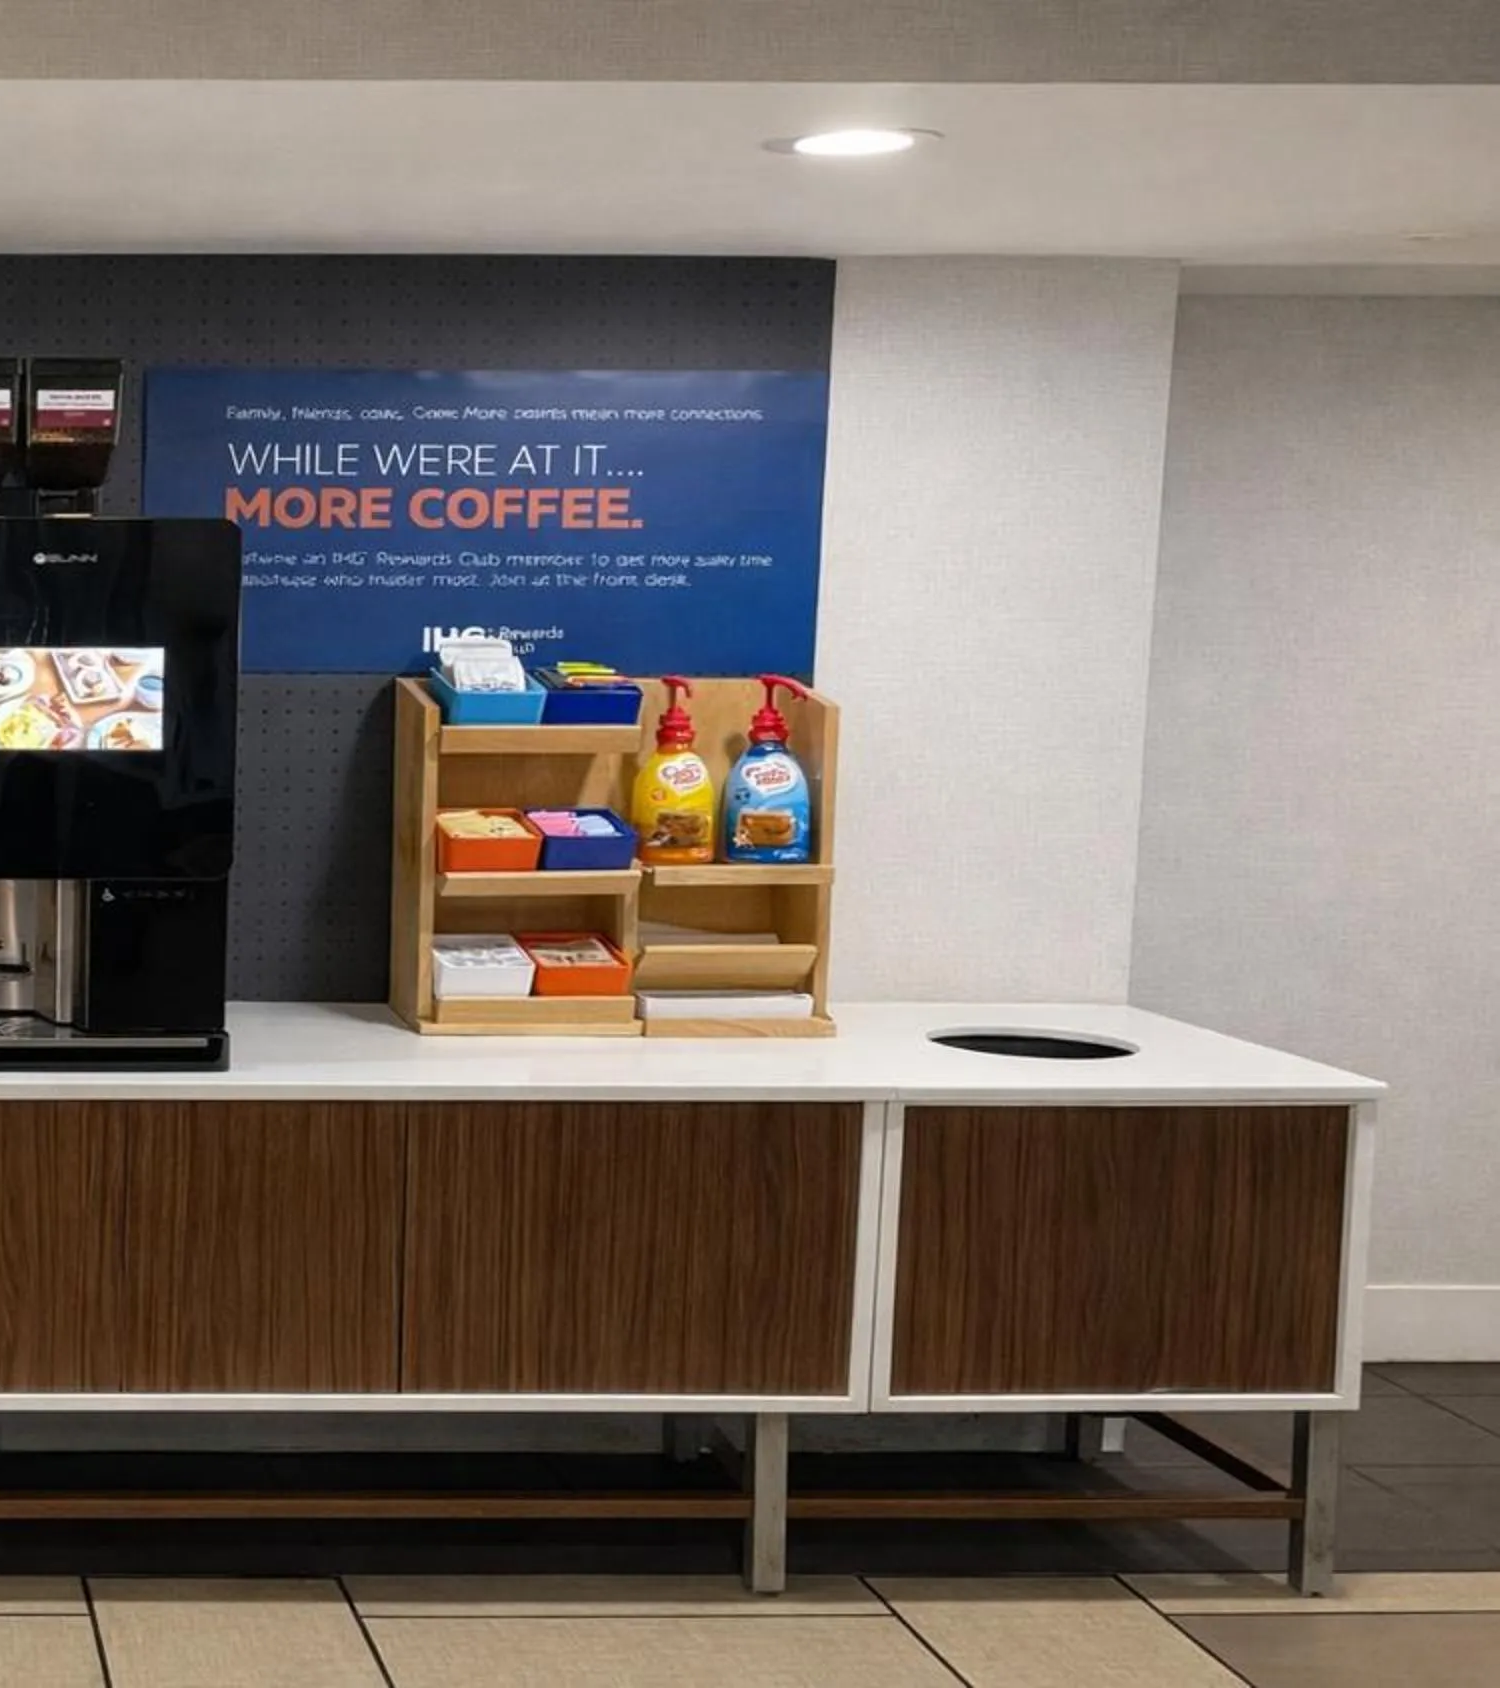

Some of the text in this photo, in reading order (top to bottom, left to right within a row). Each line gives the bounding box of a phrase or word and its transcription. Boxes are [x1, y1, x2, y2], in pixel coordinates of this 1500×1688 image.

[227, 443, 644, 477] WHILE WERE AT IT....
[224, 486, 644, 530] MORE COFFEE.
